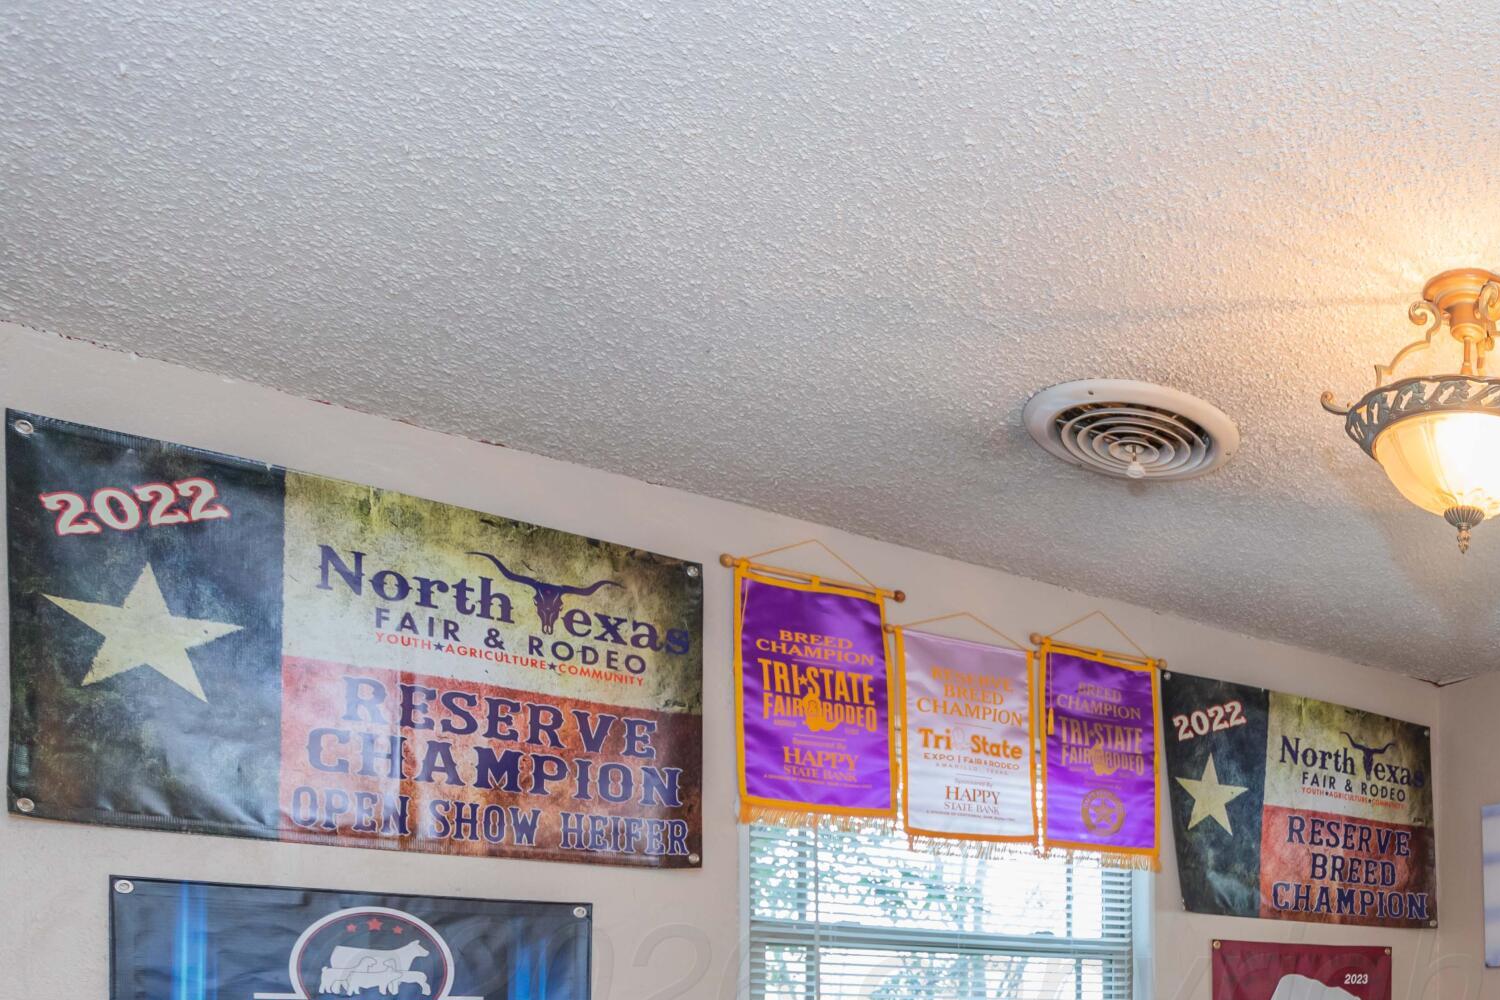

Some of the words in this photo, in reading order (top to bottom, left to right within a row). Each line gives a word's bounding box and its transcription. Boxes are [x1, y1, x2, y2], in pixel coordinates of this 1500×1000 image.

[41, 477, 231, 538] 2022
[316, 544, 514, 625] North
[375, 607, 461, 642] FAIR
[484, 626, 505, 651] &
[528, 634, 647, 675] RODEO
[755, 638, 875, 667] CHAMPION
[779, 629, 853, 650] BREED
[944, 684, 1003, 705] BREED
[1056, 694, 1141, 720] CHAMPION
[341, 674, 658, 760] RESERVE
[916, 697, 1023, 727] CHAMPION
[1172, 701, 1247, 742] 2022
[784, 746, 858, 771] HAPPY
[917, 727, 950, 750] Tri
[970, 734, 1023, 760] State
[923, 752, 954, 762] EXPO
[1279, 735, 1356, 776] North
[306, 726, 684, 809] CHAMPION
[945, 786, 1000, 805] HAPPY
[1302, 771, 1336, 789] FAIR
[1345, 779, 1352, 792] &
[1361, 782, 1406, 802] RODEO
[292, 785, 410, 837] OPEN
[428, 798, 543, 848] SHOW
[559, 810, 691, 858] HEIFER
[1286, 815, 1412, 857] RESERVE
[1310, 852, 1397, 887] BREED
[1271, 881, 1430, 919] CHAMPION
[1344, 973, 1369, 985] 2023
